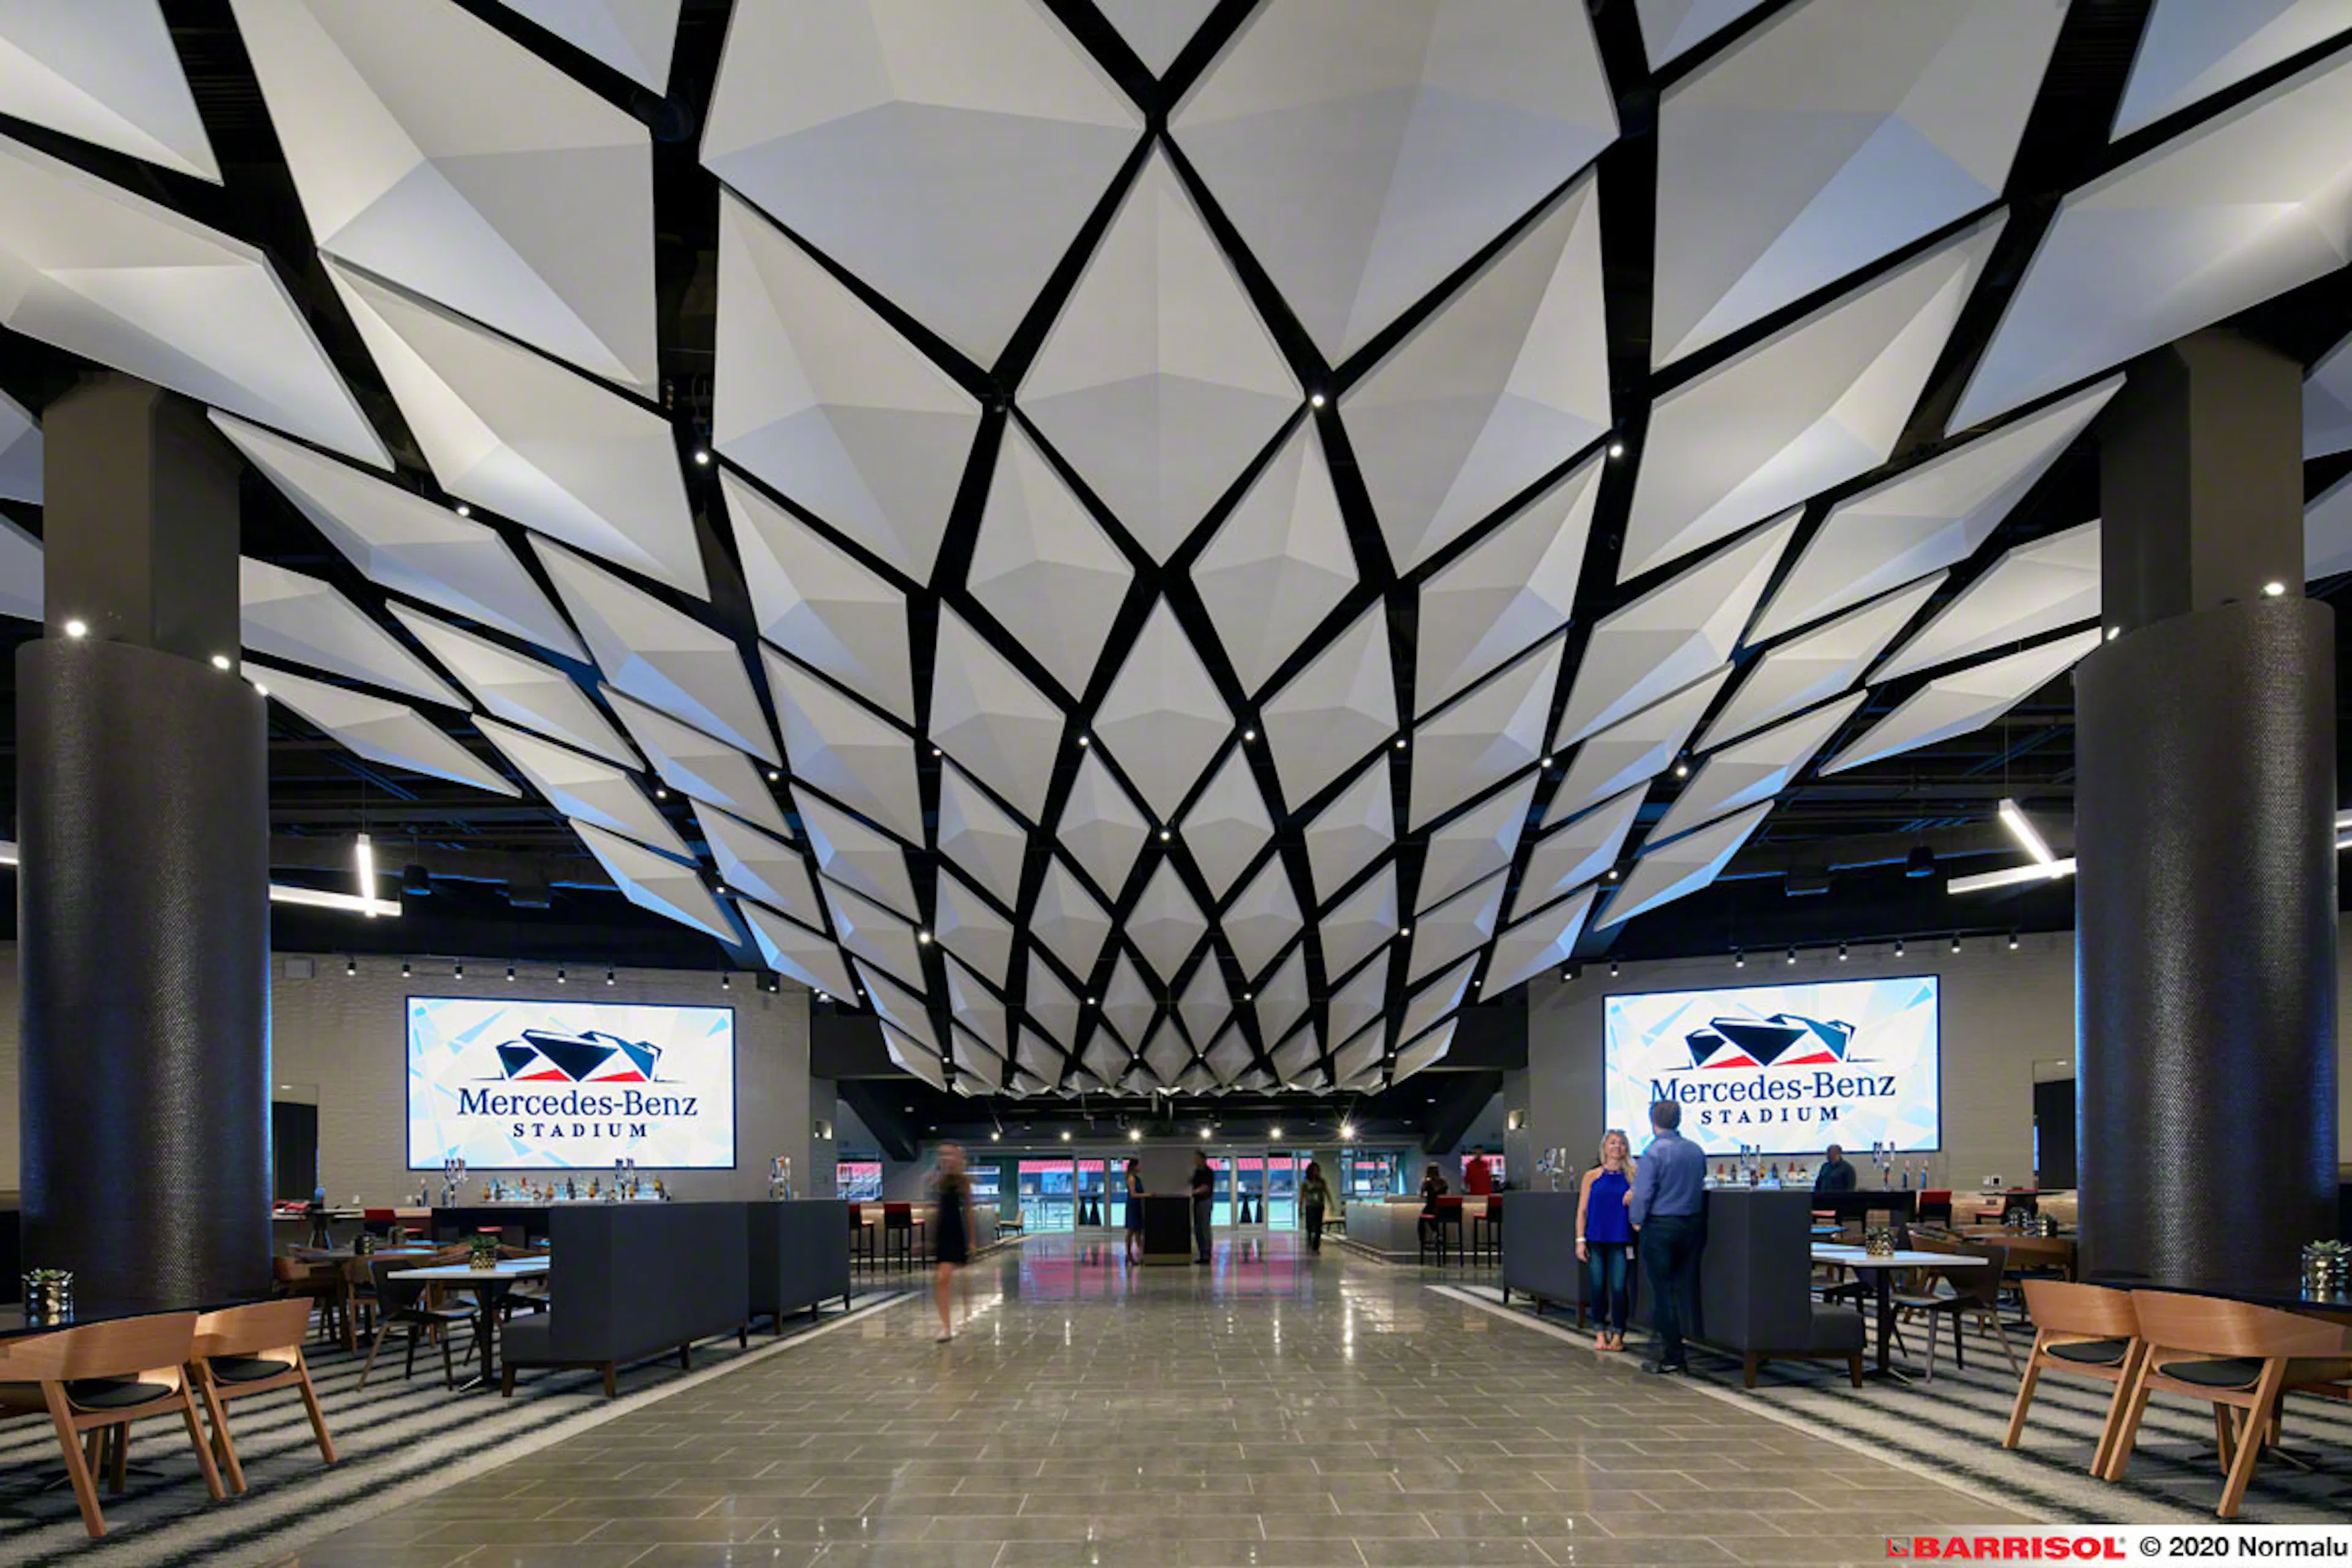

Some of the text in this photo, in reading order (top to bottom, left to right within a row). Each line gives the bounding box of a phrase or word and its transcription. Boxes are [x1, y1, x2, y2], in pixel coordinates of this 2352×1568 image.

[1650, 1071, 1896, 1103] Mercedes-Benz
[458, 1088, 697, 1116] Mercedes-Benz
[1701, 1106, 1838, 1125] STADIUM
[513, 1123, 646, 1137] STADIUM
